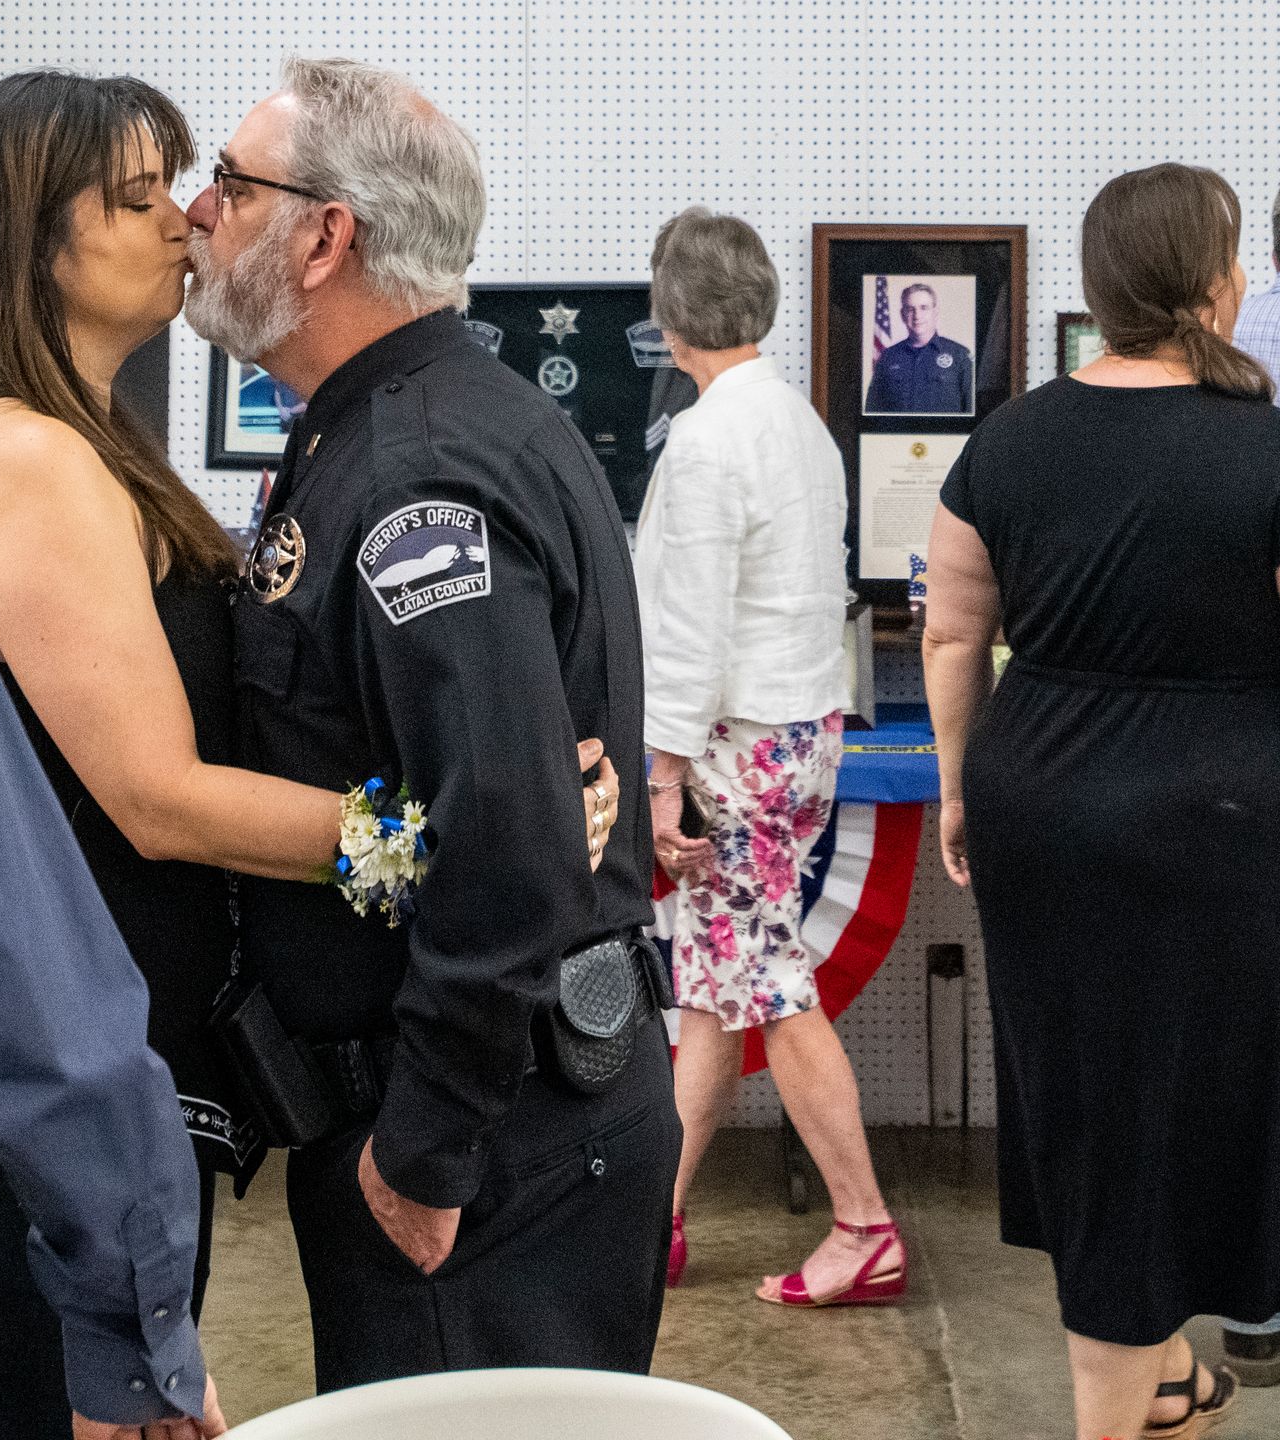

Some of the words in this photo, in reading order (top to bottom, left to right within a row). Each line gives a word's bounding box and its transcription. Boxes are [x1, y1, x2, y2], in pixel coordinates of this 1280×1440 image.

[363, 511, 422, 566] SHERIFF'S
[426, 508, 476, 531] OFFICE
[395, 590, 434, 616] LATAH
[434, 577, 485, 600] COUNTY
